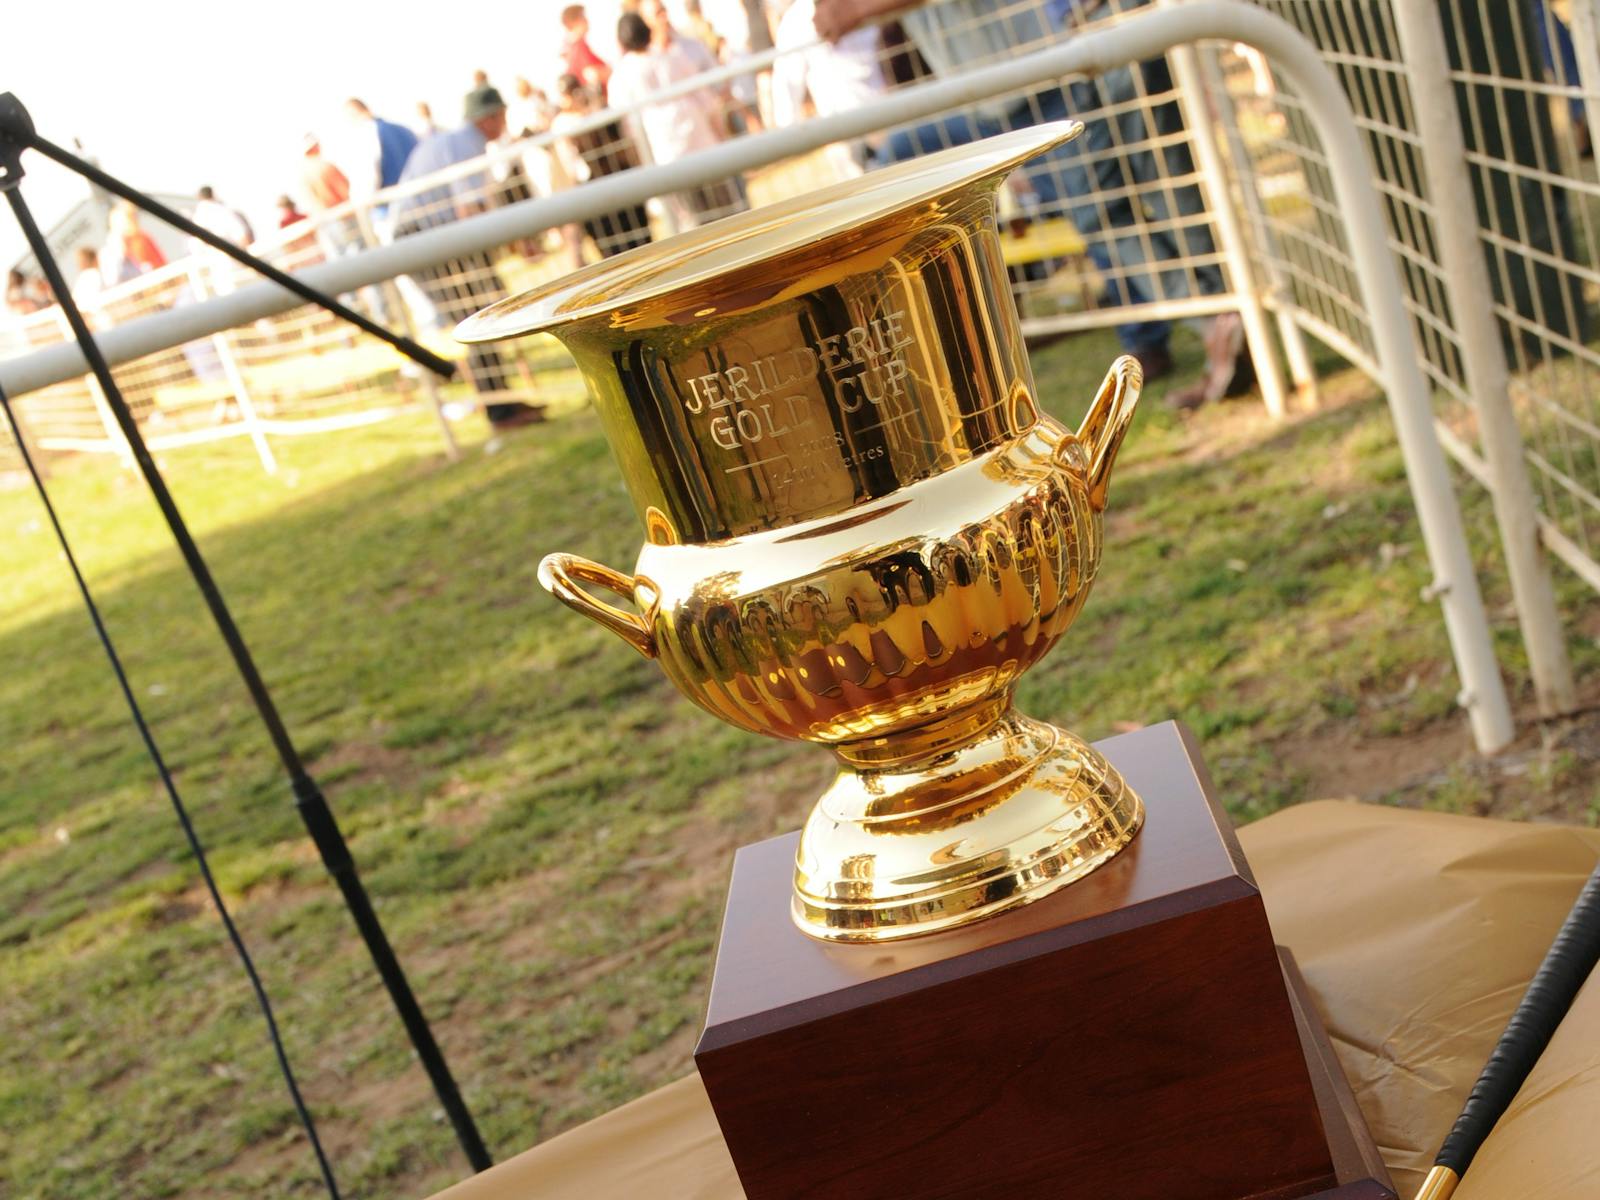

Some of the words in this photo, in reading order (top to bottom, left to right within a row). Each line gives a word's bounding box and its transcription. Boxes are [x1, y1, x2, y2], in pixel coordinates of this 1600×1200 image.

[685, 310, 914, 414] JERILDERIE
[710, 395, 815, 450] GOLD
[834, 359, 908, 413] CUP
